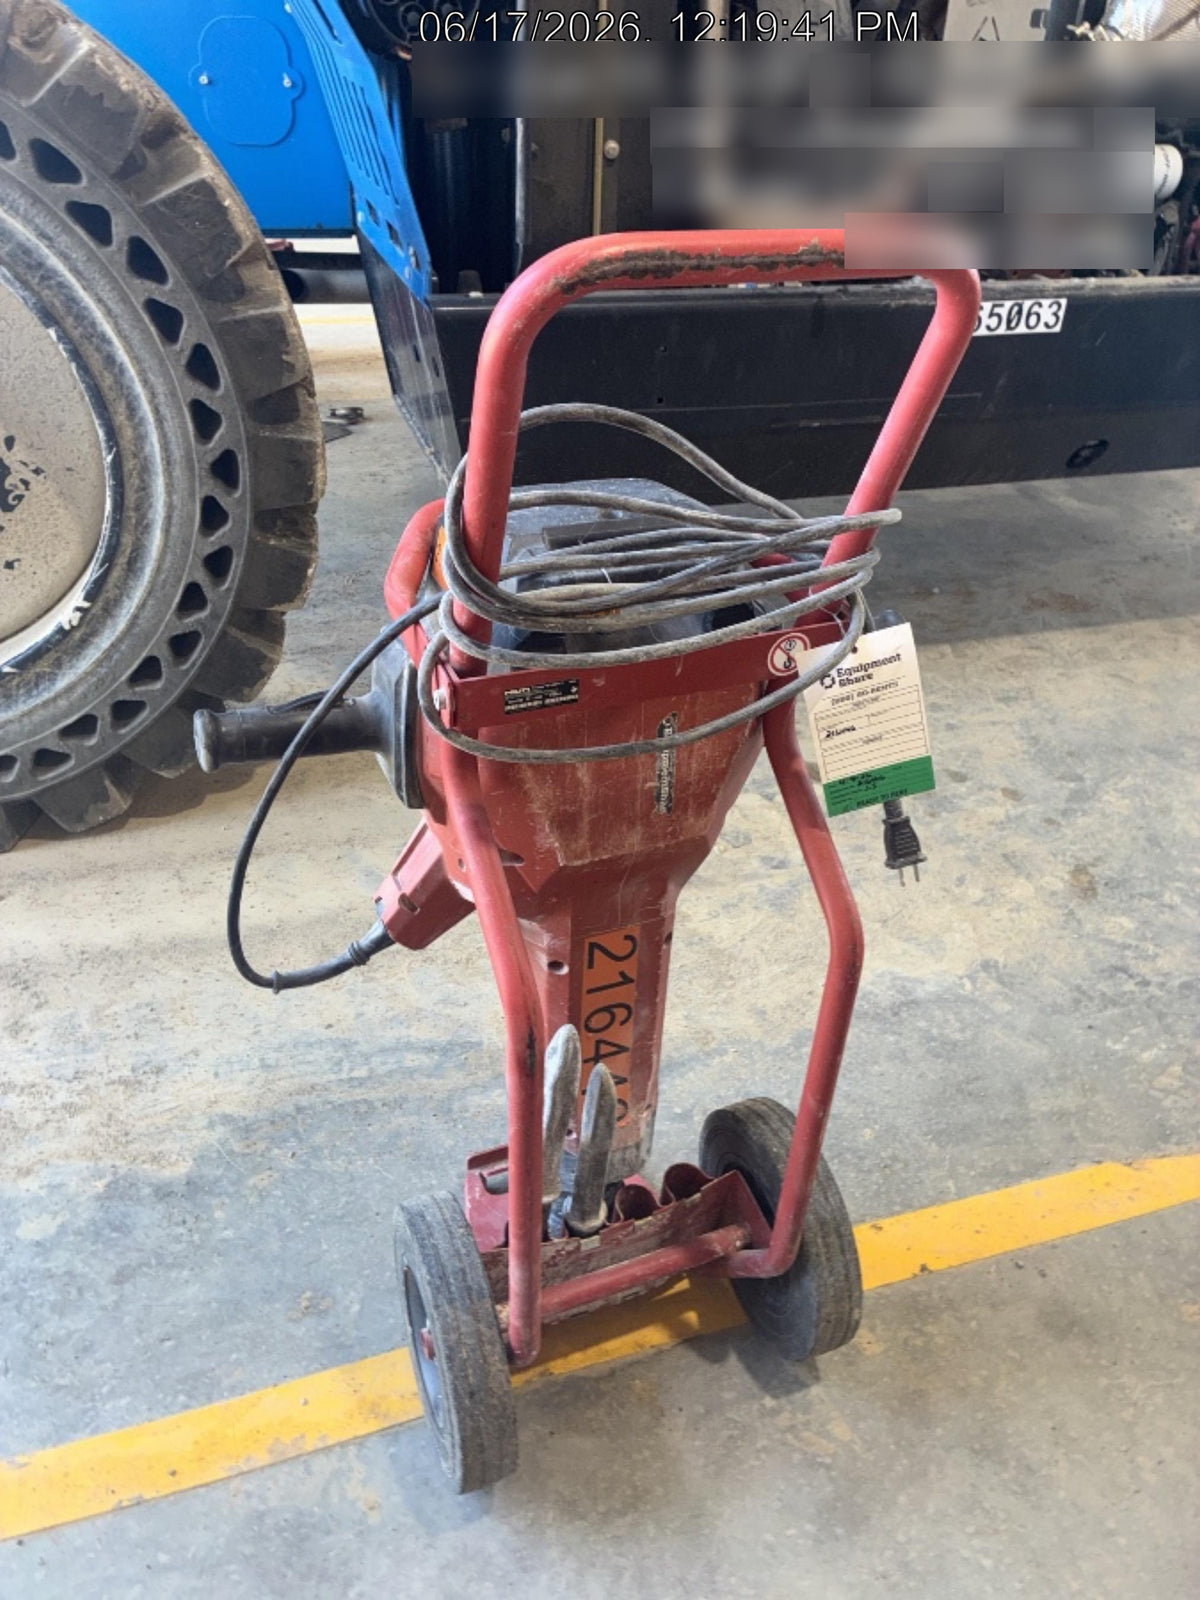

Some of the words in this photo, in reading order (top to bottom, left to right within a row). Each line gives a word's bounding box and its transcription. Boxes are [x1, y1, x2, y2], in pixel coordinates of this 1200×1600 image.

[836, 653, 902, 678] Equipment
[839, 673, 874, 688] Share
[583, 934, 638, 1122] 2164
